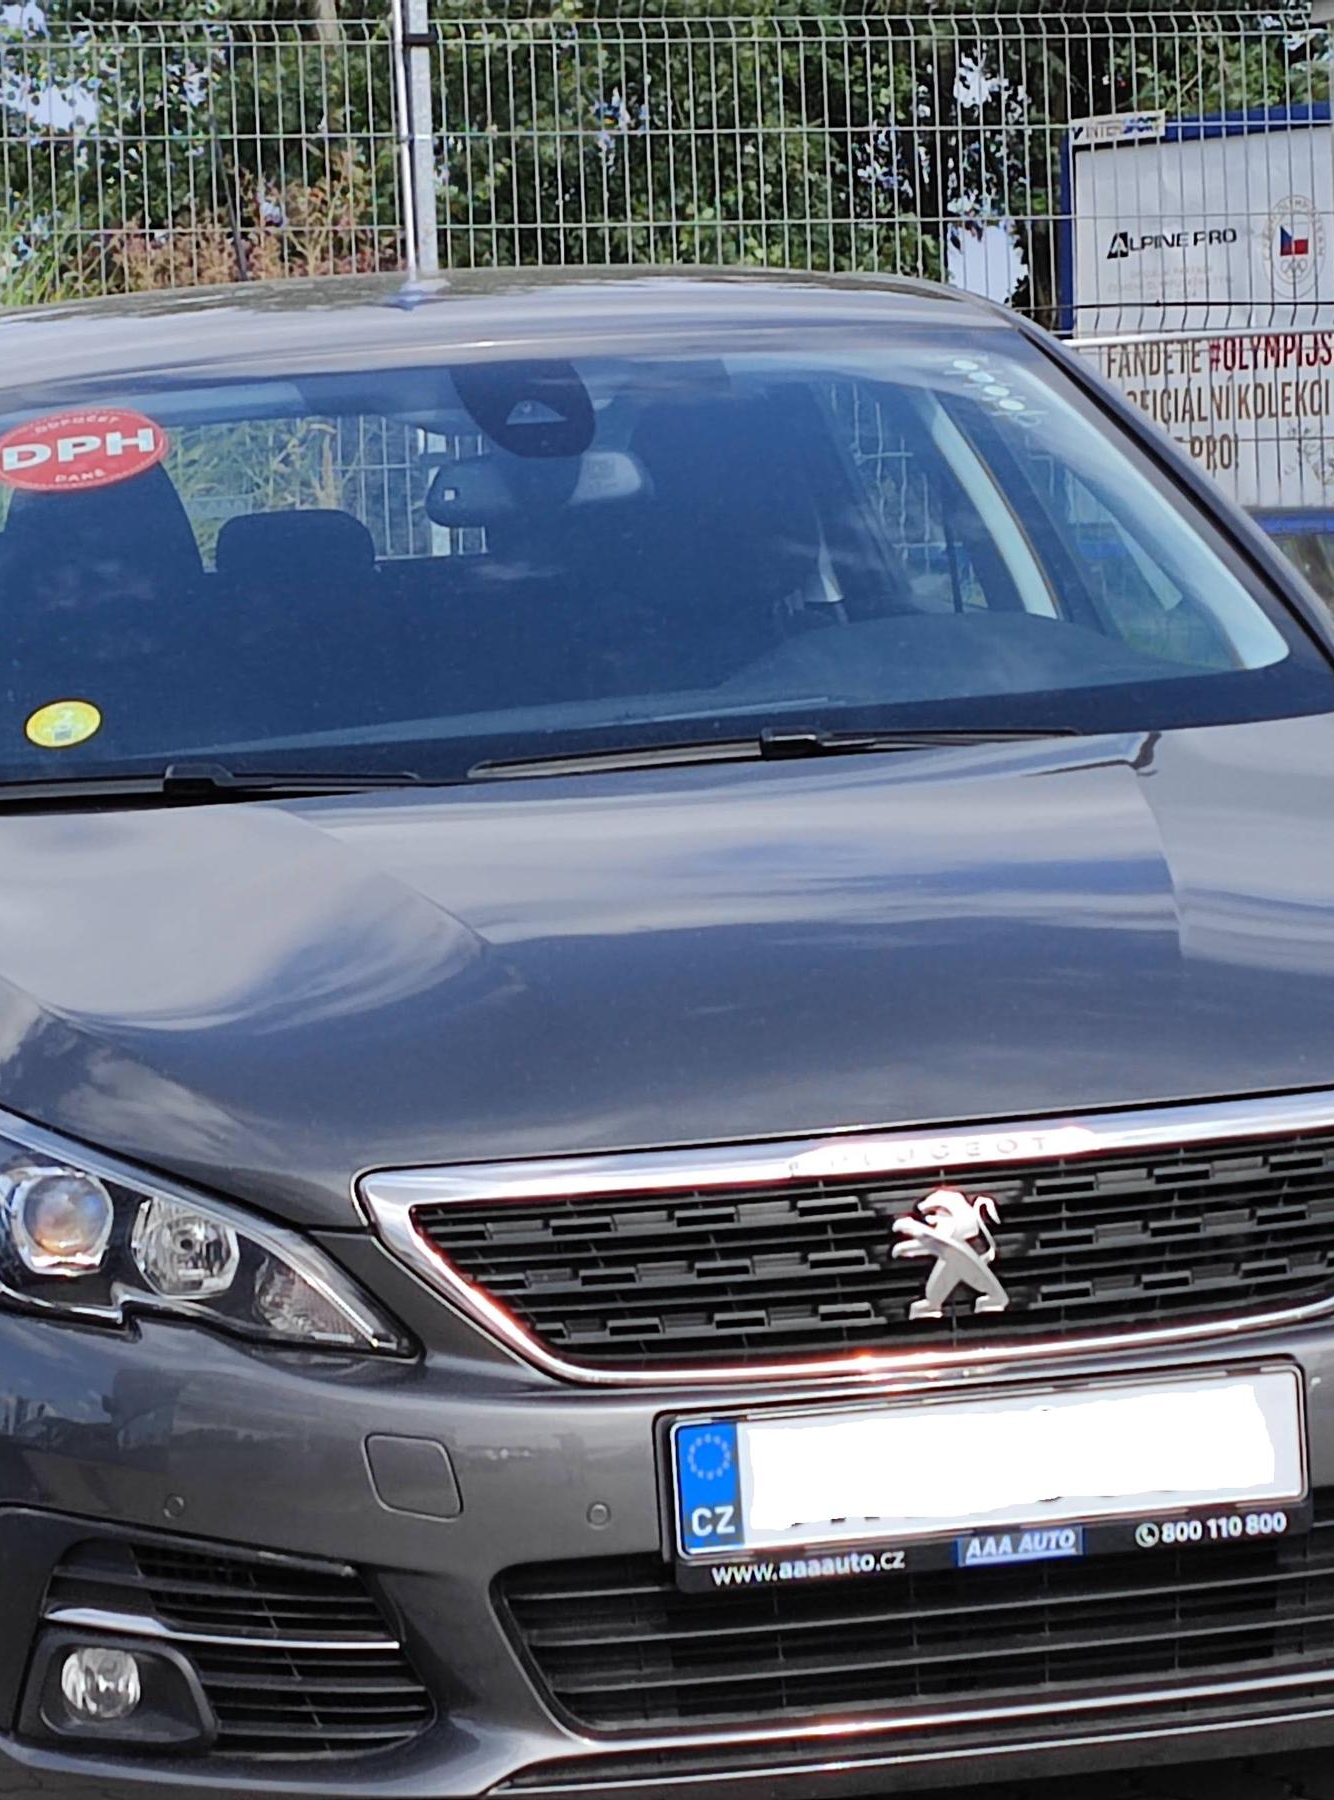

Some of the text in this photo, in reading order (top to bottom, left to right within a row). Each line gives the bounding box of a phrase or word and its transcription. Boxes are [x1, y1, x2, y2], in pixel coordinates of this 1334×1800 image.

[1106, 227, 1237, 259] ALPINE PRO
[1238, 378, 1330, 421] KOLEKCI
[2, 427, 155, 472] DPH
[691, 1506, 736, 1538] CZ
[1161, 1511, 1288, 1543] 800 110 800
[965, 1528, 1077, 1559] AAA AUTO
[711, 1550, 905, 1586] www.aaaauto.cz
